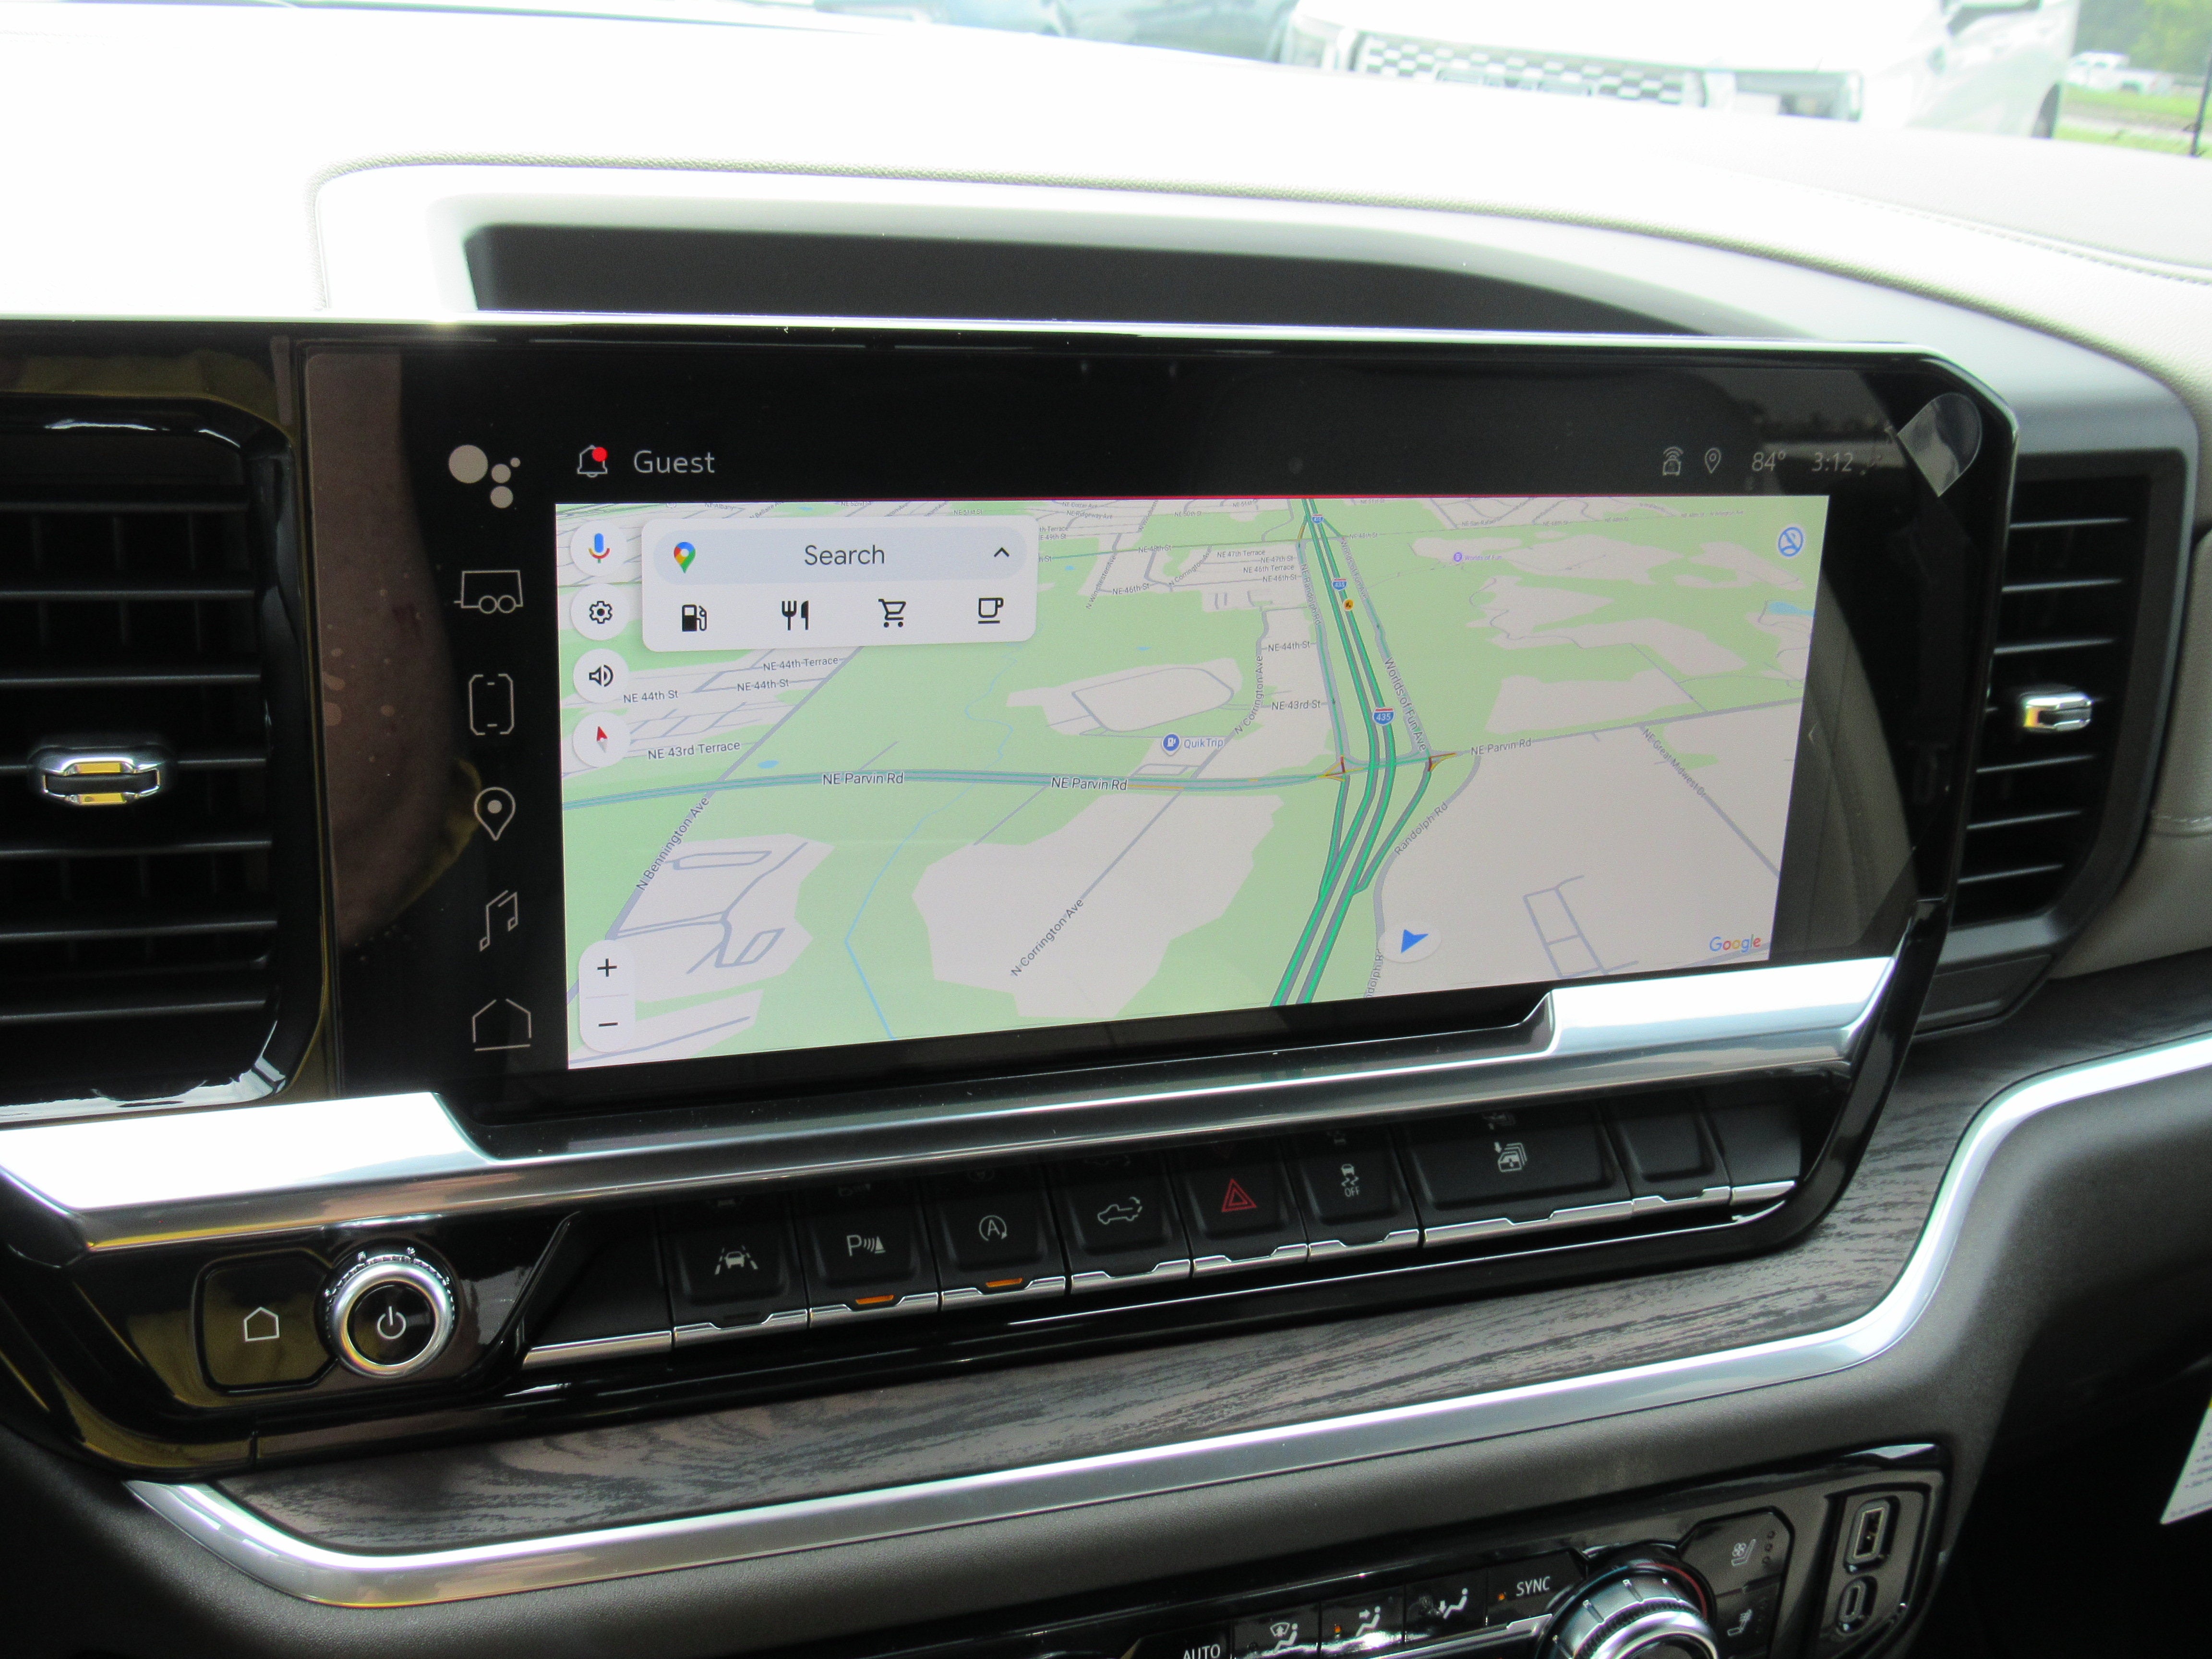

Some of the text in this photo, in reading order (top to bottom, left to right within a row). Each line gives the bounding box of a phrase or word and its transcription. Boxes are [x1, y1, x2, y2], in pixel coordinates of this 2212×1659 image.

[634, 450, 715, 473] Guest
[1812, 452, 1853, 472] 3:12
[1076, 511, 1102, 519] Ridgeway
[804, 545, 885, 565] Search
[1341, 540, 1353, 564] Worlds
[1088, 566, 1109, 602] Winchester
[1106, 555, 1117, 569] Ave
[1175, 559, 1205, 583] Corrington
[1301, 564, 1320, 625] NE Randolph Rd
[763, 658, 838, 671] NE 44th Terrace
[737, 679, 789, 691] NE 44th St
[624, 690, 679, 703] NE 44th St
[1234, 724, 1243, 735] N
[1243, 674, 1264, 727] Corrington
[1272, 702, 1285, 710] NE
[1311, 700, 1321, 708] St
[1384, 657, 1427, 752] Worlds of Fun Ave
[648, 742, 740, 759] NE 43rd Terrace
[1471, 738, 1531, 756] NE Parvin Rd
[1643, 728, 1706, 797] NE Great Midwest Dr
[822, 772, 904, 784] NE Parvin Rd
[1051, 777, 1128, 791] NE Parvin Rd
[1394, 802, 1448, 855] Randolph Rd
[636, 798, 709, 890] N Bennington Ave
[1011, 900, 1083, 976] N Corrington Ave
[1709, 934, 1761, 953] Google
[1345, 1186, 1359, 1197] OFF
[1515, 1576, 1551, 1597] SYNC
[1183, 1644, 1221, 1659] AUTO
